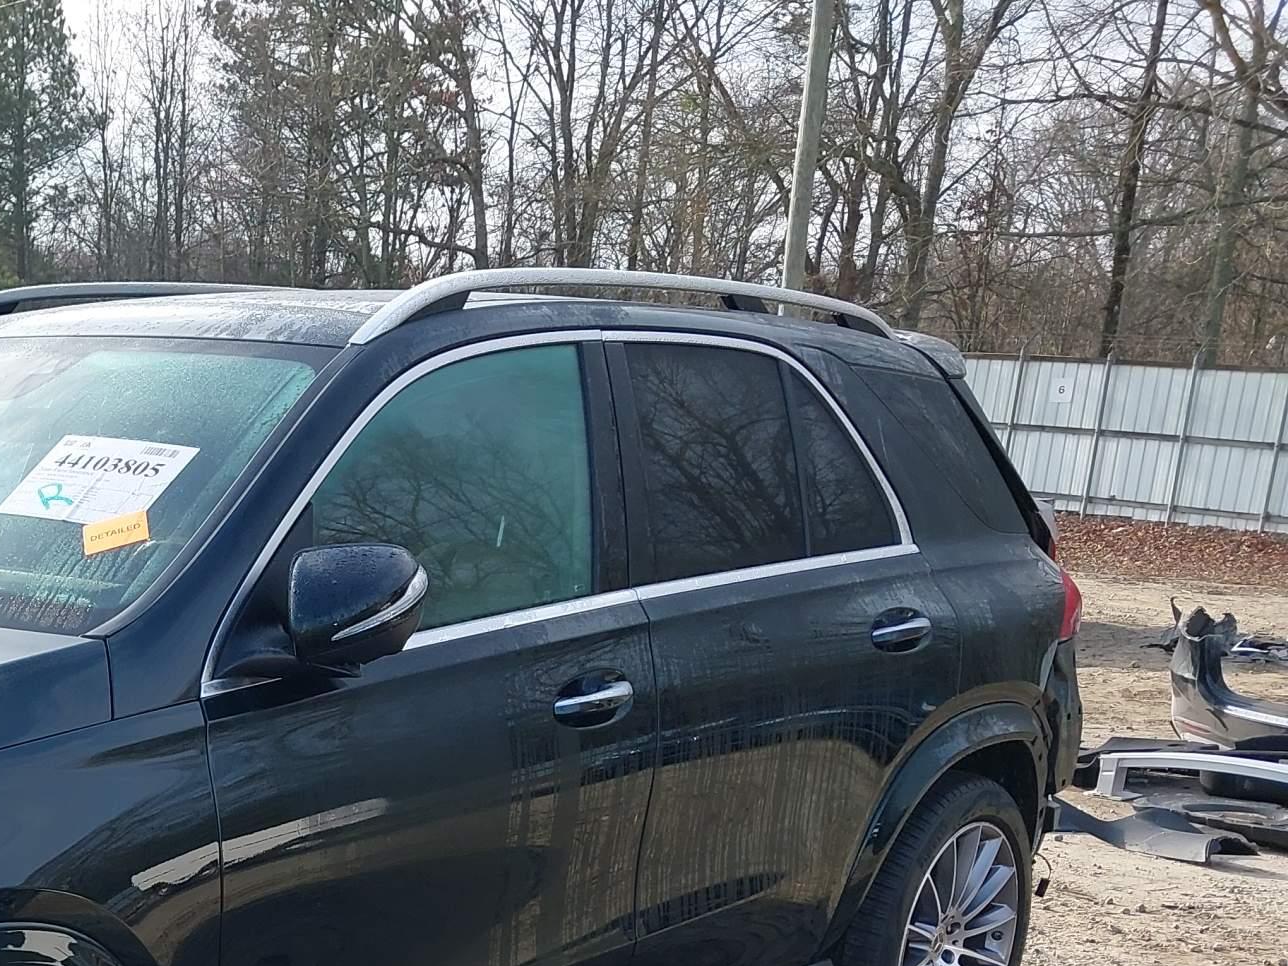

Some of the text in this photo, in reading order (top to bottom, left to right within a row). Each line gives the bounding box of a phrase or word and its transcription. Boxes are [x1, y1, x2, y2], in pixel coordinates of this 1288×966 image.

[1059, 386, 1065, 394] 6
[54, 452, 166, 478] 44103805
[37, 483, 73, 510] R
[90, 522, 141, 542] DETAILED
